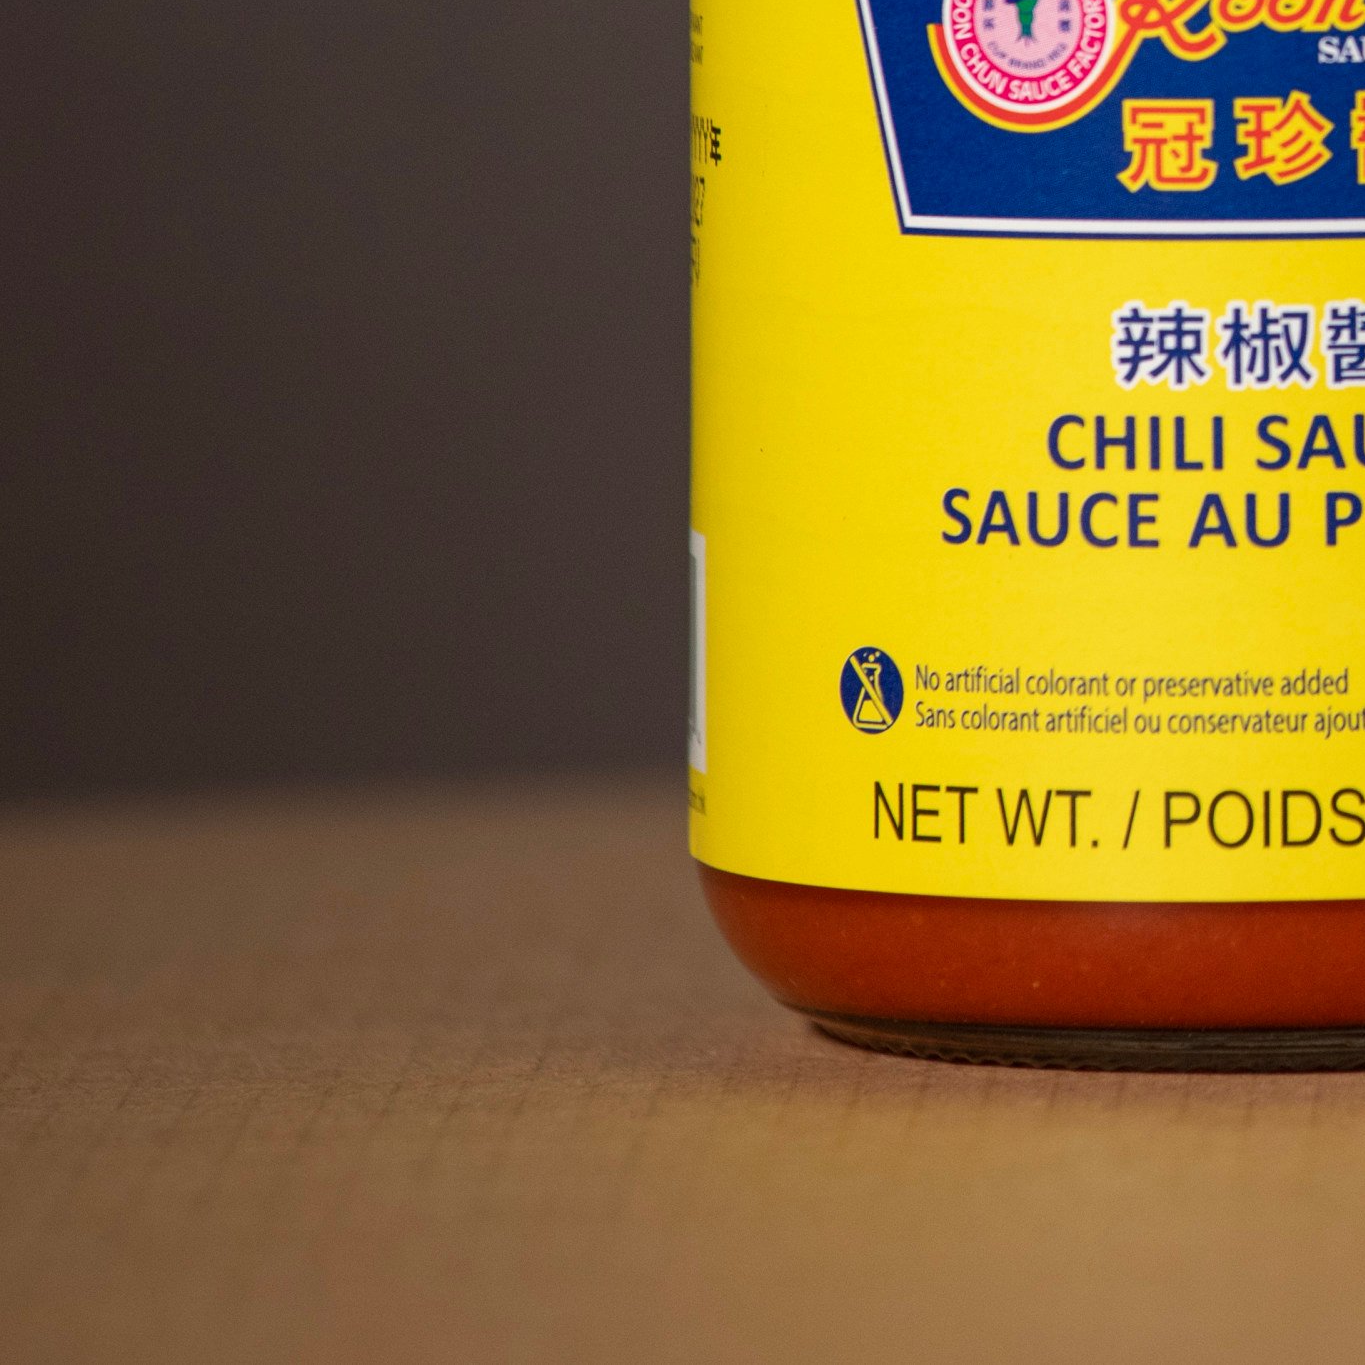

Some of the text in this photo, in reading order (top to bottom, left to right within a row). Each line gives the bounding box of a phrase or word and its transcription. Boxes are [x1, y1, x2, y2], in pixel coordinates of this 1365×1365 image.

[960, 40, 1008, 95] CHUN
[1007, 68, 1075, 103] SAUCE
[1047, 414, 1225, 472] CHILI
[941, 487, 1161, 549] SAUCE
[1188, 492, 1293, 550] AU
[915, 664, 1349, 704] No artificial colorant or preservative added
[915, 700, 956, 729] Sans
[960, 703, 1040, 732] colorant
[1045, 705, 1128, 734] artificiel
[1134, 713, 1161, 734] ou
[1167, 709, 1309, 734] conservateur
[873, 780, 978, 844] NET
[996, 786, 1100, 848] WT.
[1121, 790, 1141, 850] /
